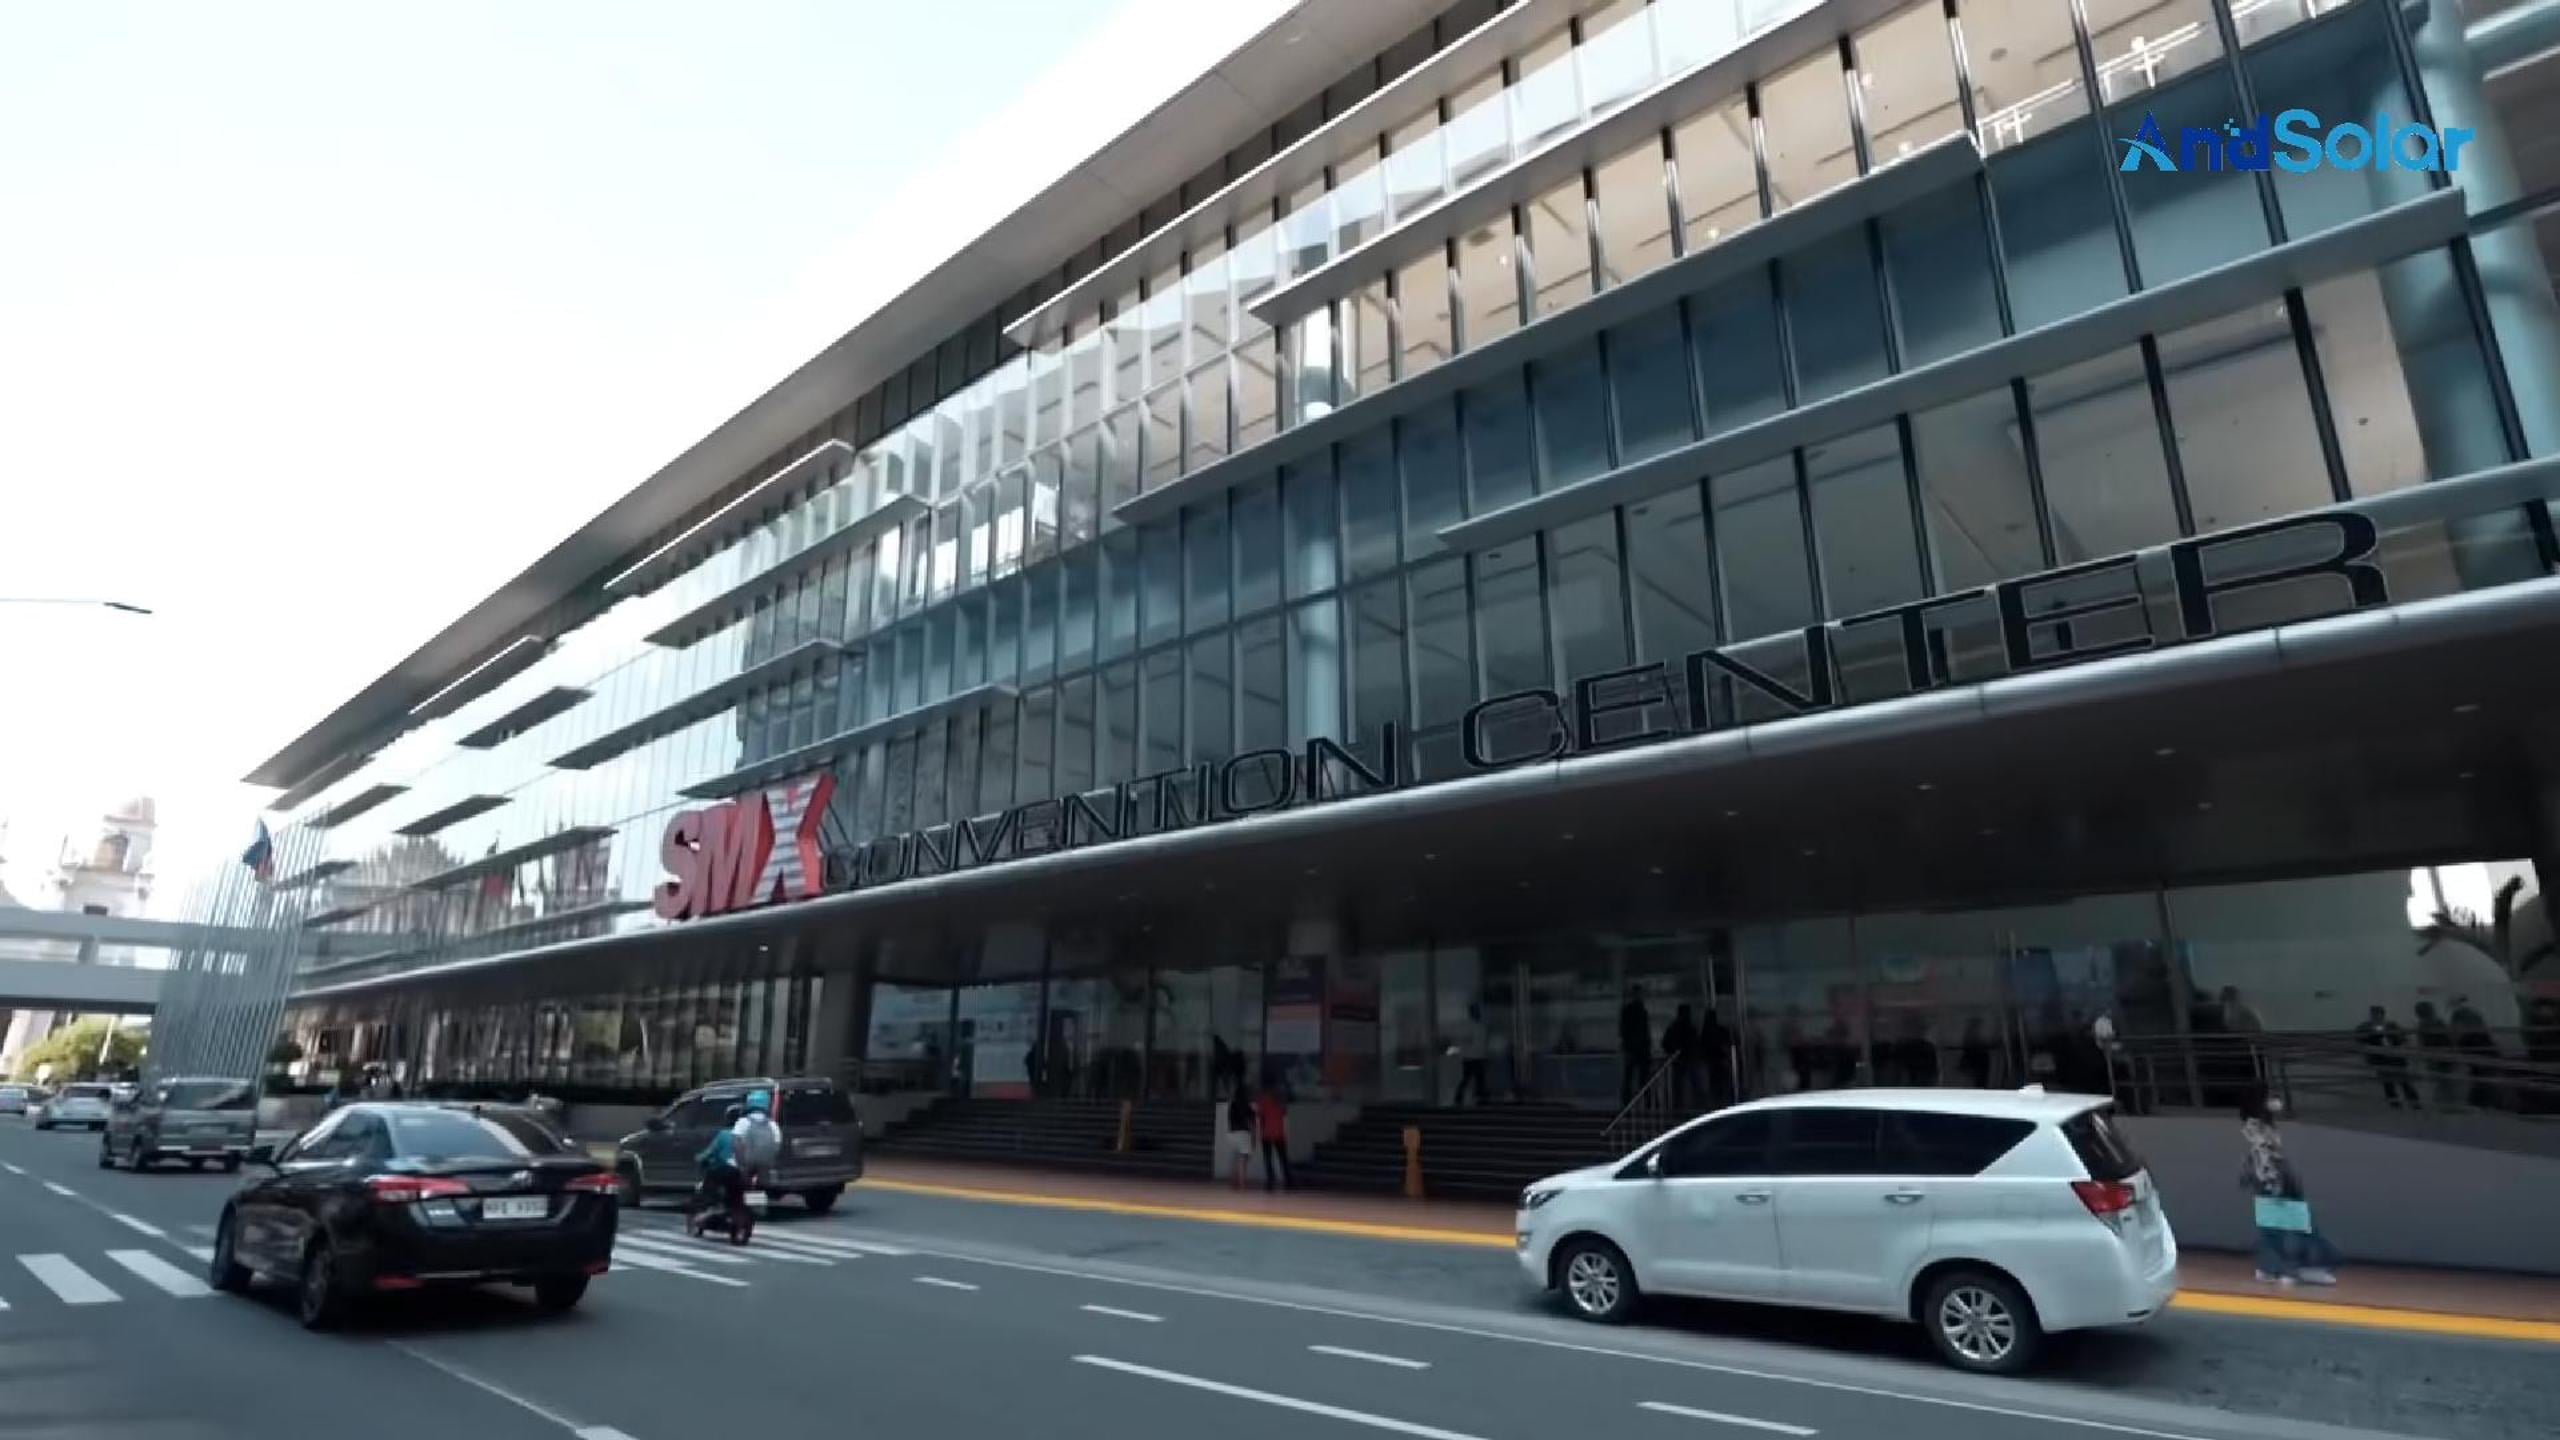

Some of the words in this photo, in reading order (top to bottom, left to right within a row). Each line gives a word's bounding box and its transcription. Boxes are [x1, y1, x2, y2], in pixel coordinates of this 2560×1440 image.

[654, 770, 837, 922] SMX
[826, 719, 1397, 891] CONVENTION
[1462, 511, 2389, 769] CENTER
